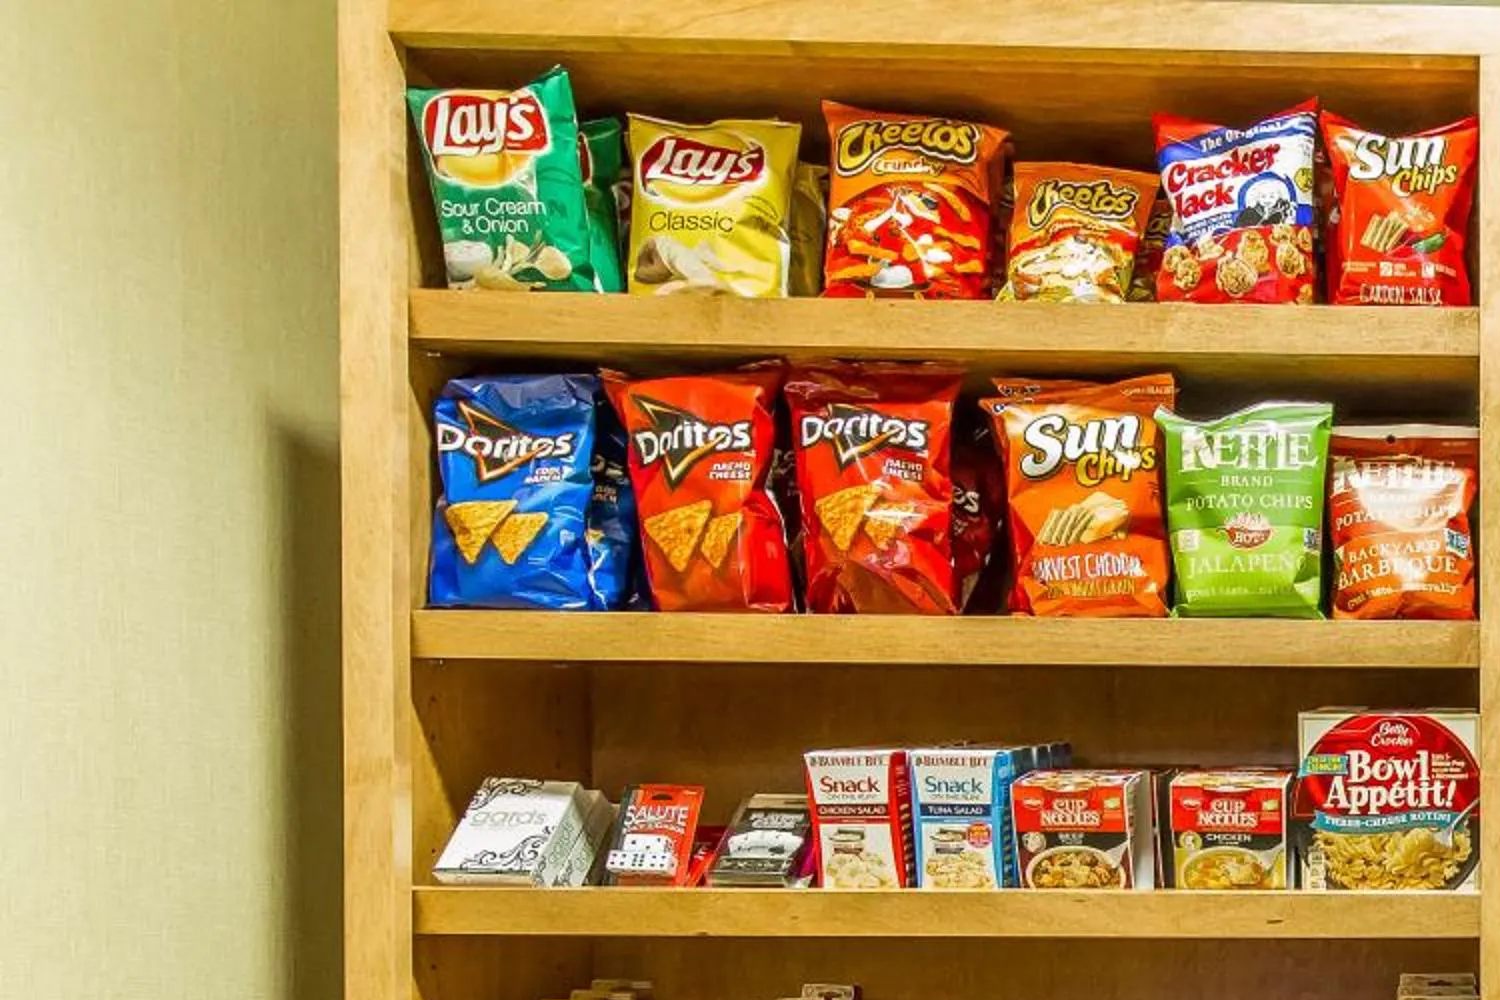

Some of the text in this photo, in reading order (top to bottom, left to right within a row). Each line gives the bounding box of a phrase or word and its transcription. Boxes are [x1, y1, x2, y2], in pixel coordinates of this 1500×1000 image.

[434, 97, 535, 156] Lay's
[838, 120, 977, 173] Cheetos
[1200, 136, 1222, 151] The
[646, 138, 761, 185] Lay's
[1350, 135, 1446, 179] Sun
[1167, 144, 1281, 192] Cracker
[1392, 161, 1457, 198] Chips
[441, 198, 546, 217] Sour Cream
[1029, 181, 1137, 228] Cheetos
[476, 215, 528, 233] Onion
[649, 212, 734, 233] Classic
[437, 422, 573, 459] Doritos
[802, 412, 929, 448] Doritos
[635, 421, 751, 464] Doritos
[1021, 414, 1140, 478] Sun
[1220, 475, 1273, 487] BRAND
[1186, 495, 1313, 511] POTATO CHIPS
[1349, 539, 1441, 563] BACKYARD
[1379, 721, 1409, 738] Betty
[1345, 750, 1430, 783] Bowl
[820, 775, 881, 793] Snack
[925, 775, 984, 794] Snack
[1053, 798, 1087, 812] CUP
[1211, 798, 1246, 812] CUP
[1323, 775, 1457, 815] Appétit!
[624, 805, 689, 826] SALUTE
[858, 805, 886, 815] SALAD
[928, 805, 983, 815] TUNA SALAD
[1040, 810, 1101, 827] NOODLES
[1199, 810, 1259, 827] NOODLES
[1205, 833, 1251, 843] CHICKEN
